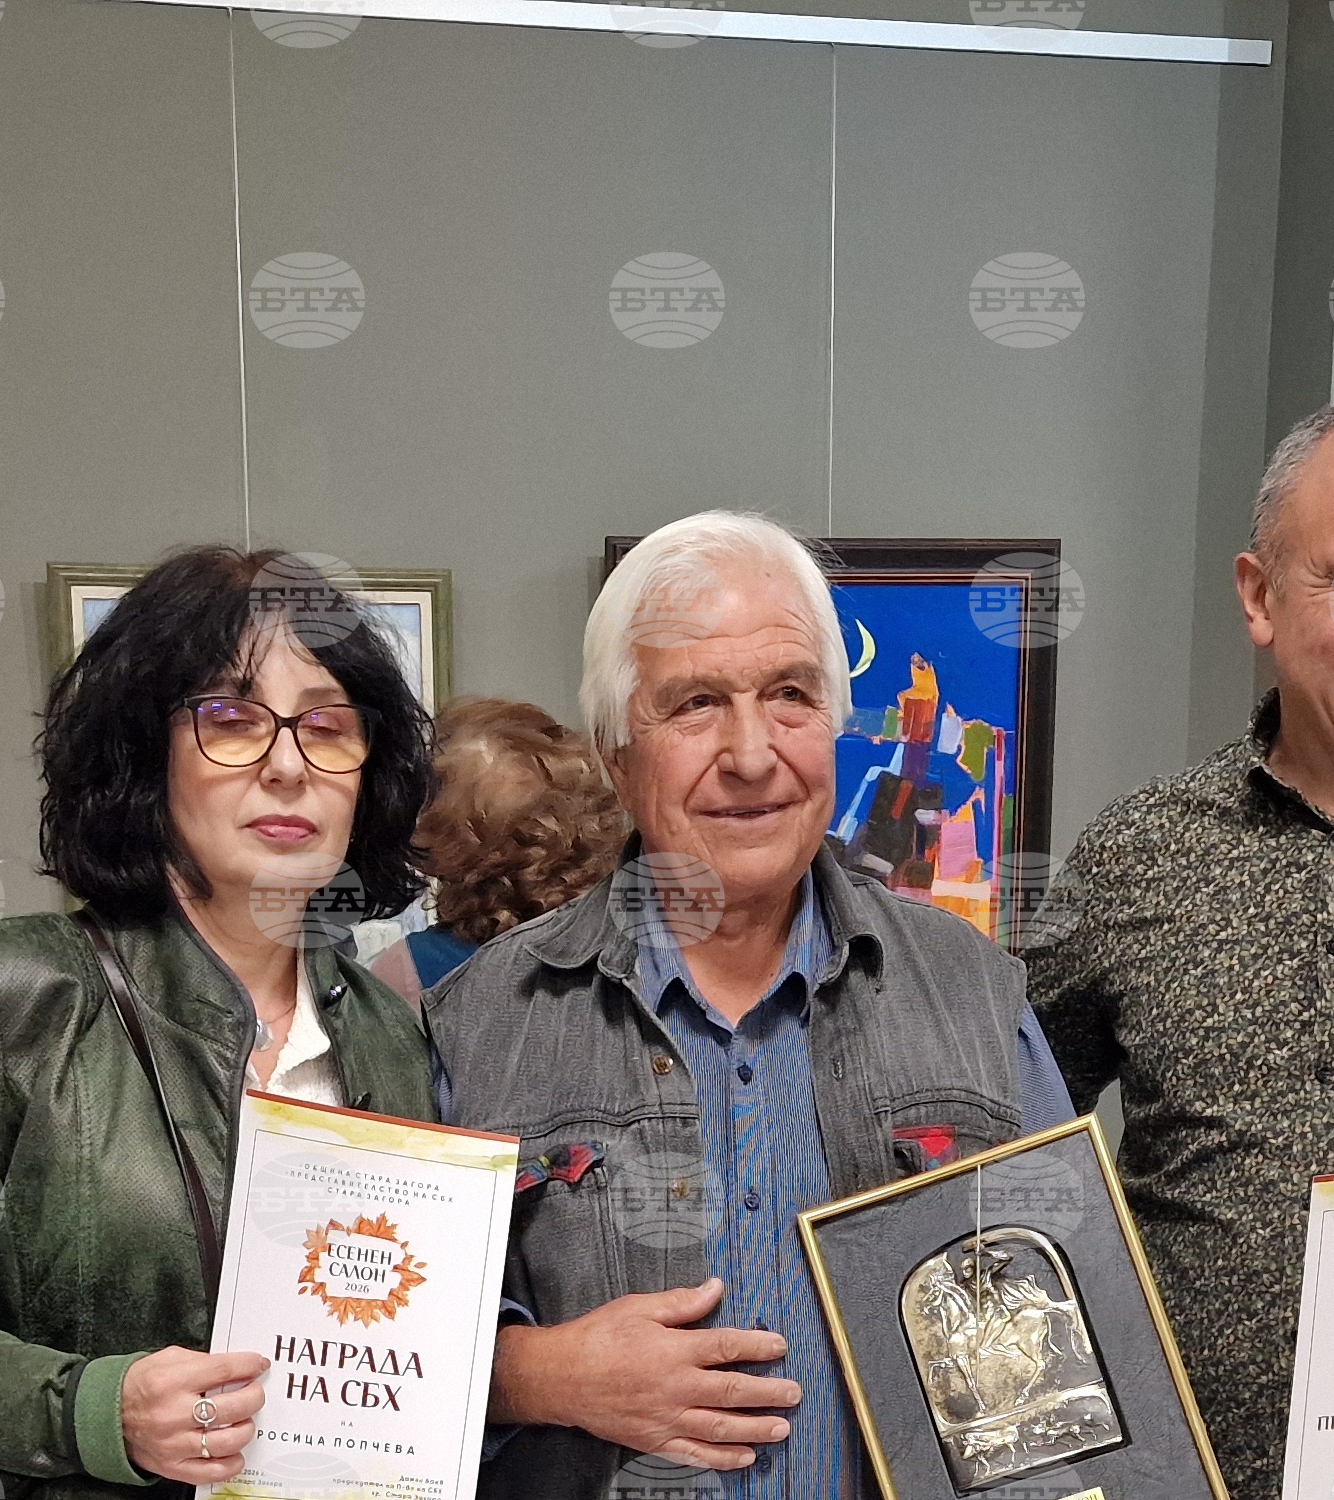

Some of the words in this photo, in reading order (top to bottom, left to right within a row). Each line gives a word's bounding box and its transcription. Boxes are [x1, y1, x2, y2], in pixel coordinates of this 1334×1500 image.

[355, 1171, 391, 1184] СТАРА
[395, 1178, 440, 1191] ЗАГОРА
[327, 1186, 363, 1199] СТАРА
[367, 1192, 410, 1206] ЗАГОРА
[413, 1191, 427, 1199] НА
[327, 1242, 393, 1266] ЕСЕНЕН
[328, 1261, 387, 1284] САЛОН
[344, 1282, 370, 1294] 2026
[274, 1334, 424, 1379] НАГРАДА
[286, 1372, 330, 1404] НА
[340, 1379, 403, 1412] СБХ
[256, 1429, 326, 1447] РОСИЦА
[333, 1437, 416, 1456] ПОПЧЕВА
